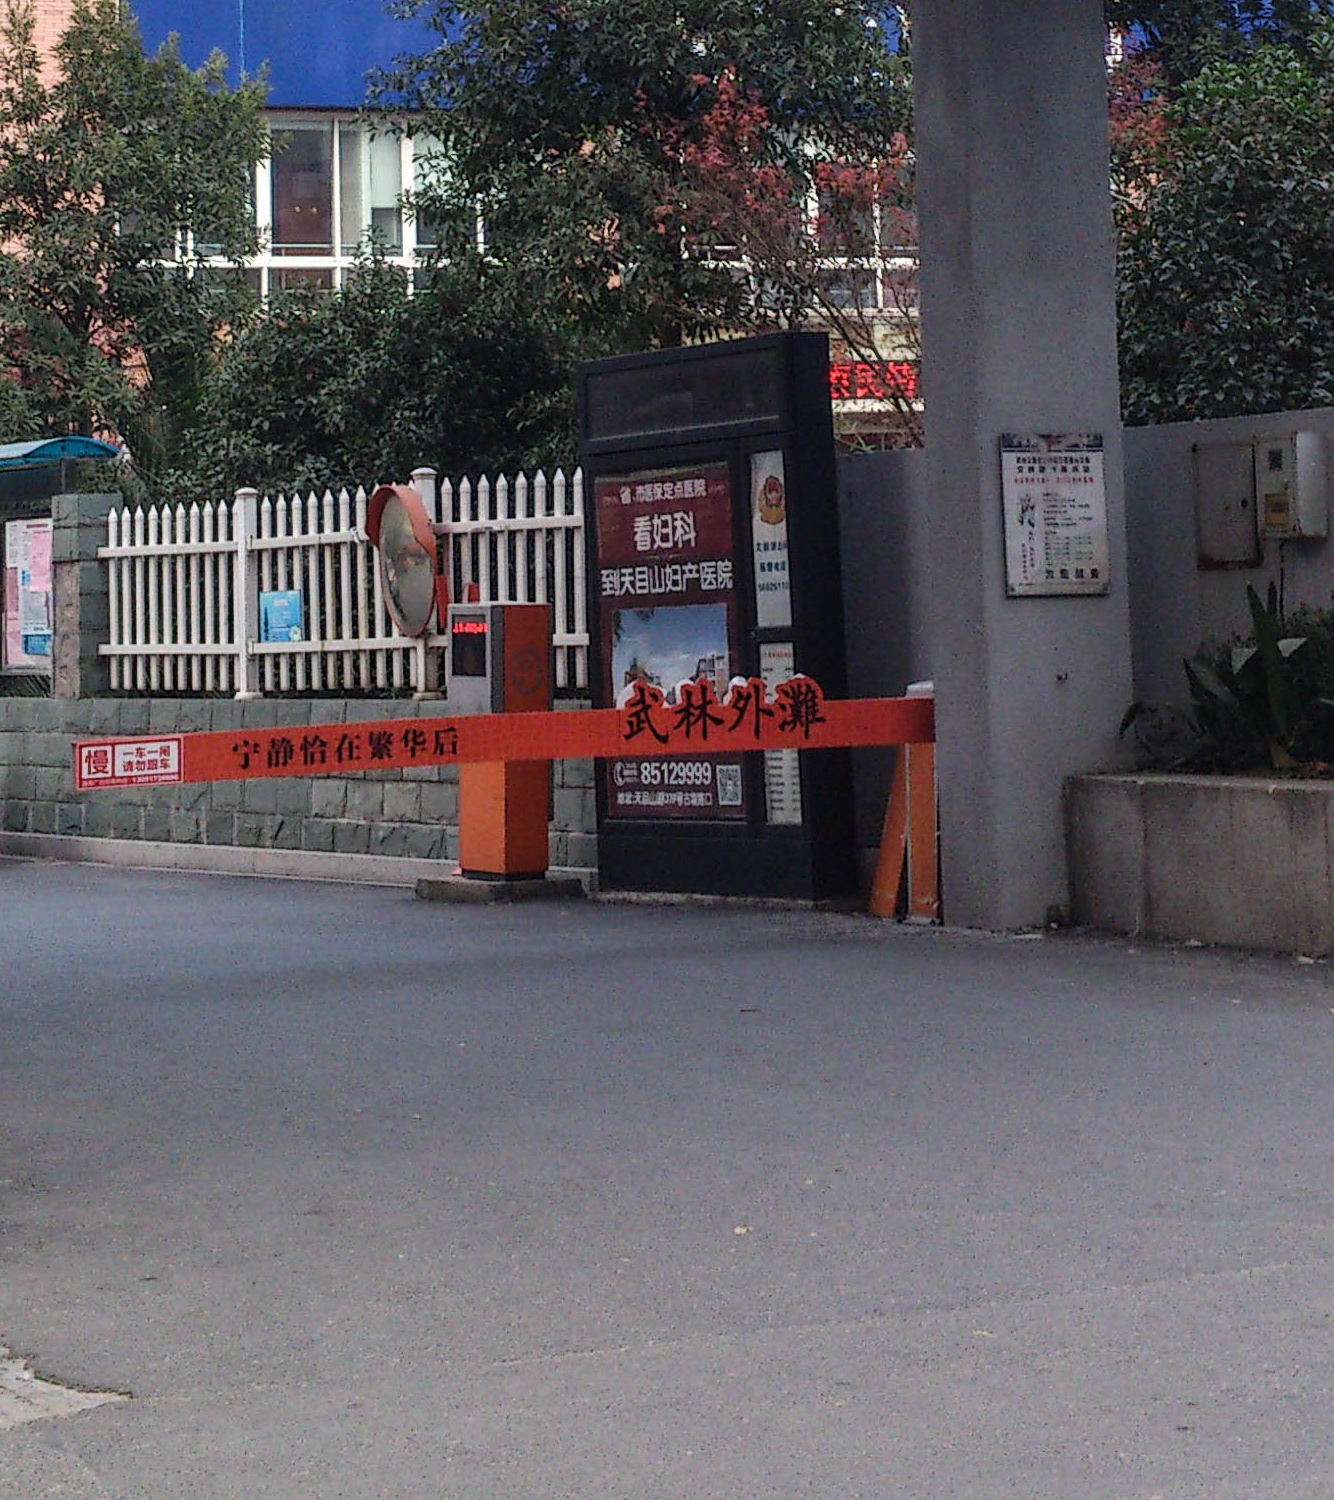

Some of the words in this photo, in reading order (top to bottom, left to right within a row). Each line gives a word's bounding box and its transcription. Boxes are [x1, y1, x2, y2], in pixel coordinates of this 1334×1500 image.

[633, 510, 697, 552] 看妇科
[600, 559, 734, 597] 到天目山妇产医院
[623, 682, 826, 744] 武林外滩
[85, 749, 109, 776] 慢
[232, 726, 459, 770] 宁静恰在繁华后
[640, 761, 712, 786] 85129999
